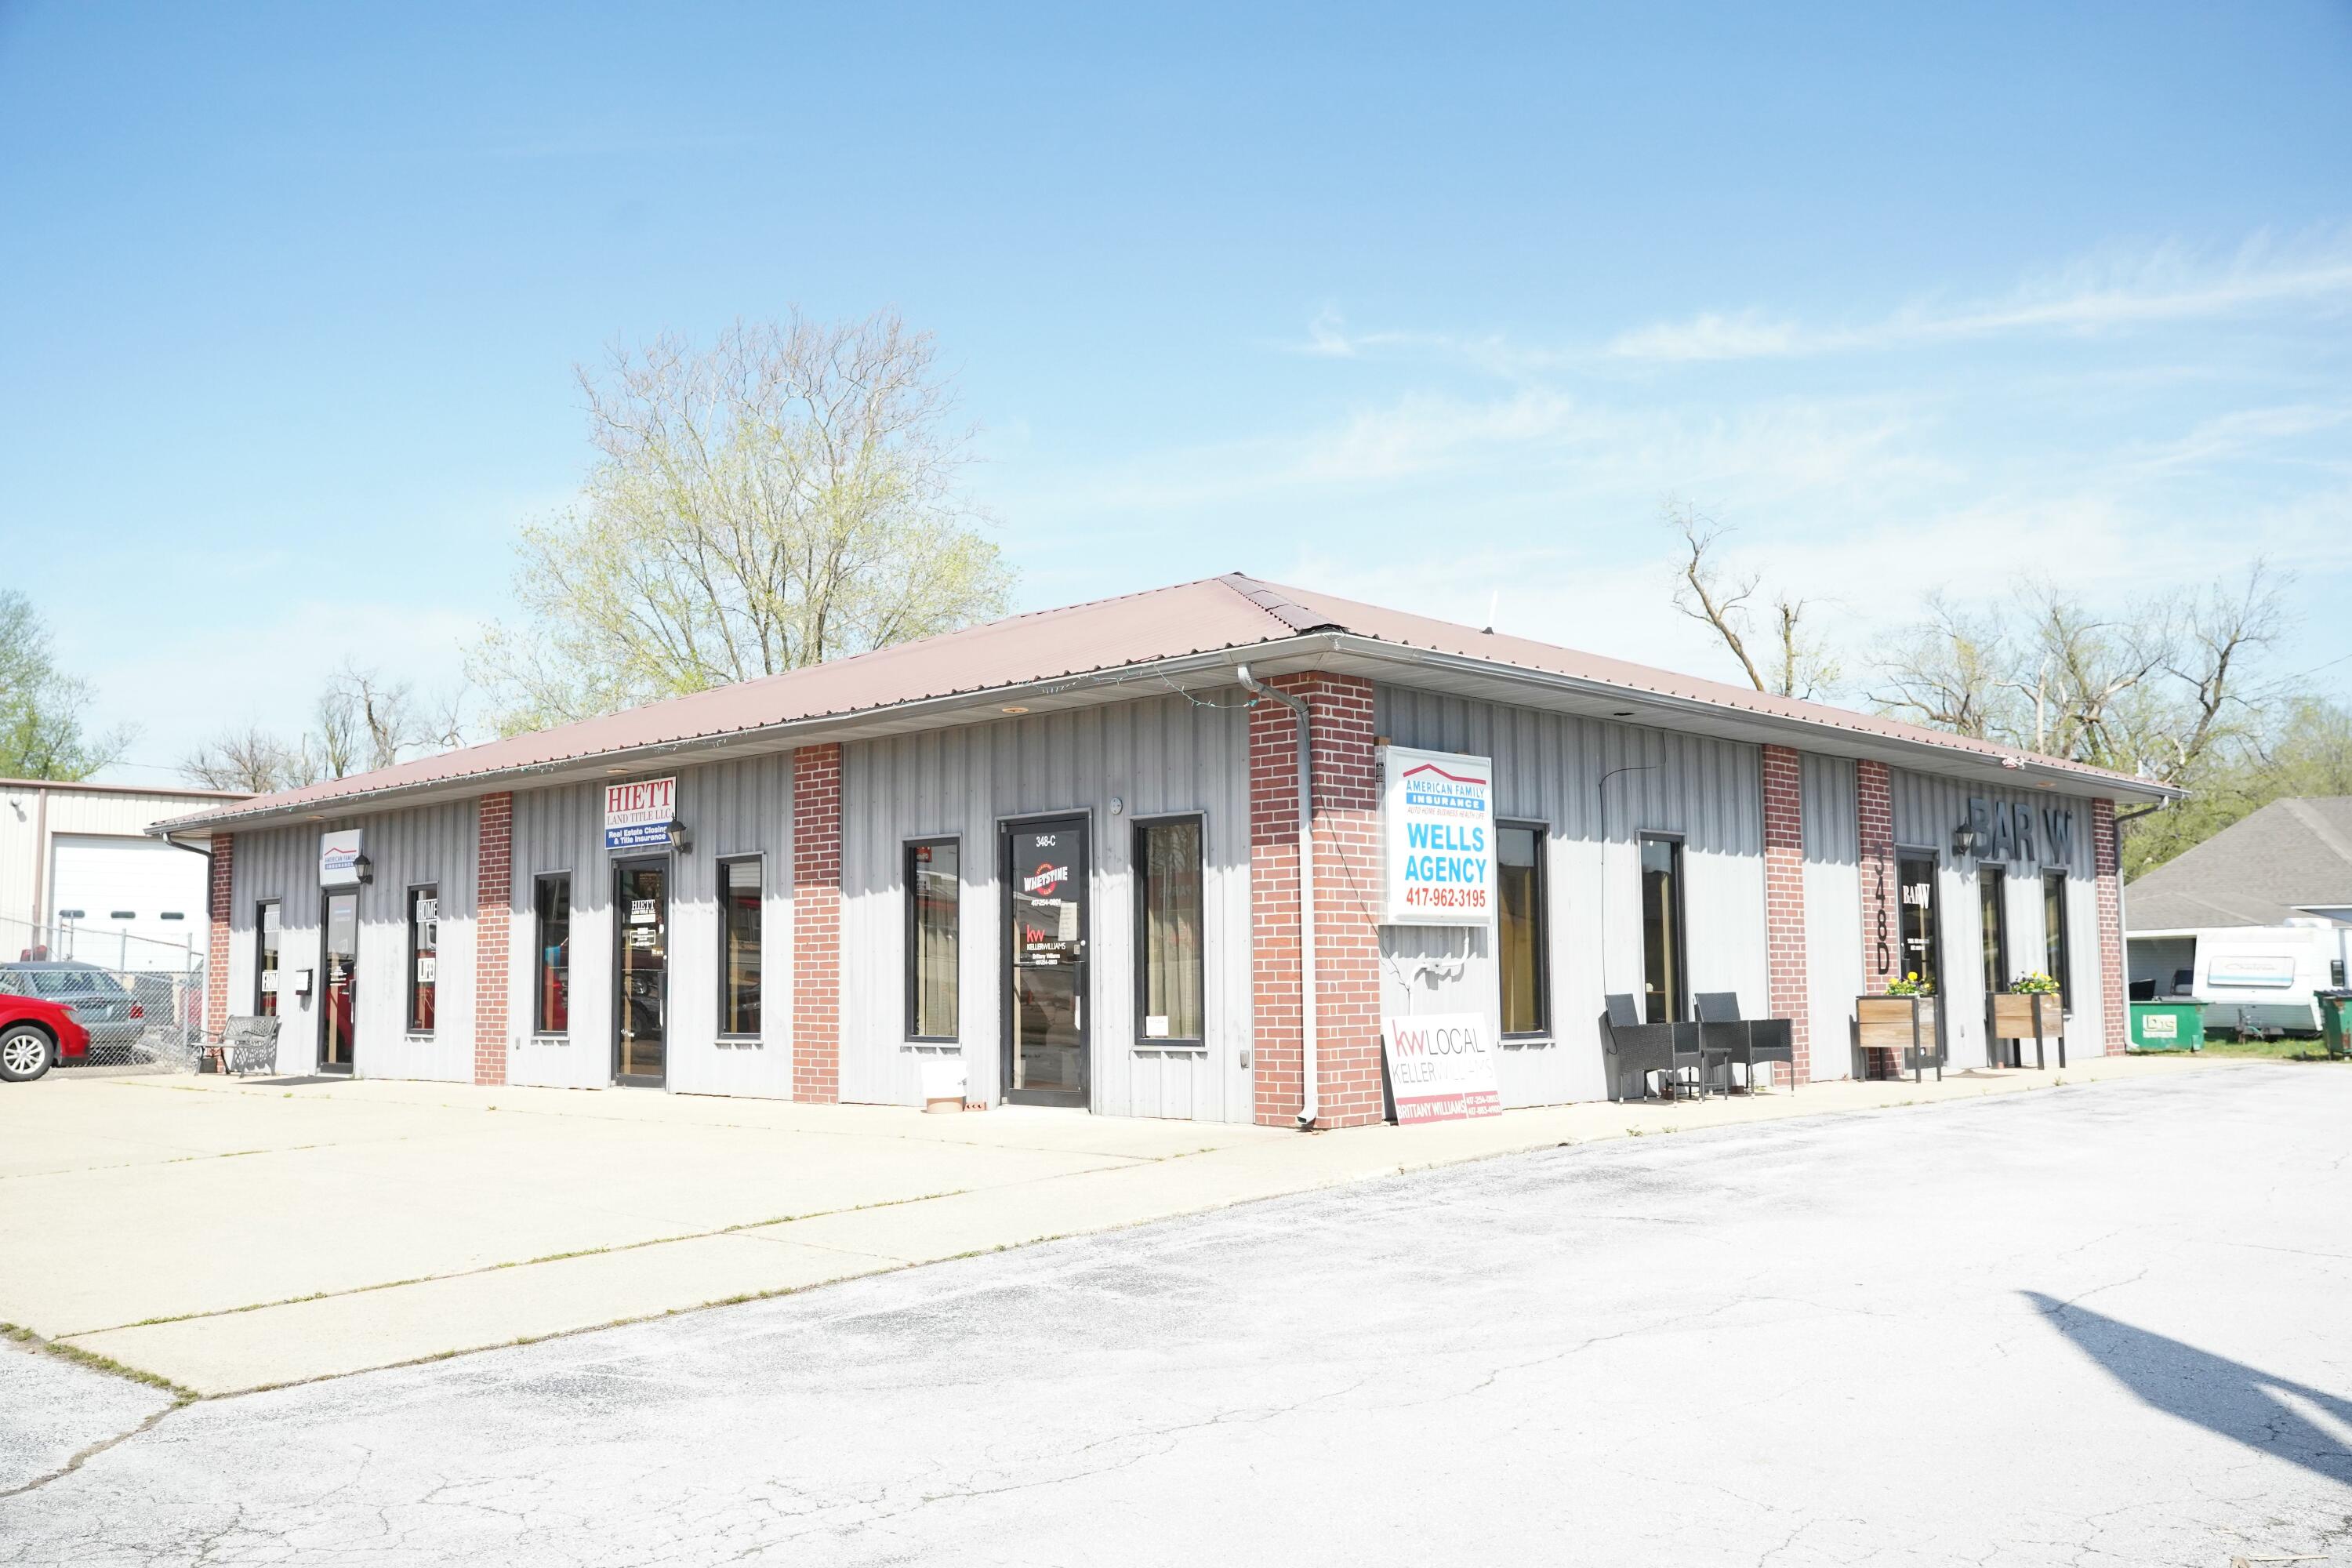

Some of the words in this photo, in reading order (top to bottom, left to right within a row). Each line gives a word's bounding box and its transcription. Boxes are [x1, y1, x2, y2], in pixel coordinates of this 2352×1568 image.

[608, 780, 673, 813] HIETT
[1406, 779, 1453, 795] AMERICAN
[1455, 785, 1485, 798] FAMILY
[1413, 794, 1480, 809] INSURANCE
[608, 815, 628, 826] LAND
[630, 811, 653, 822] TITLE
[655, 808, 671, 820] LLC
[608, 830, 622, 839] Real
[624, 828, 643, 837] Estate
[620, 836, 633, 844] Title
[635, 833, 666, 843] Insurance
[1407, 822, 1485, 852] WELLS
[1969, 797, 2035, 862] BAR
[2043, 808, 2074, 865] W
[1036, 835, 1056, 848] 348-C
[1405, 855, 1486, 884] AGENCY
[1023, 866, 1068, 892] WHETSTINE
[631, 899, 655, 910] HIETT
[1406, 887, 1486, 907] 417-962-3195
[418, 902, 437, 920] HOME
[1027, 924, 1045, 942] kw
[419, 960, 434, 980] LIFE
[1425, 1028, 1486, 1055] LOCAL
[1396, 1102, 1432, 1120] BRITTANY
